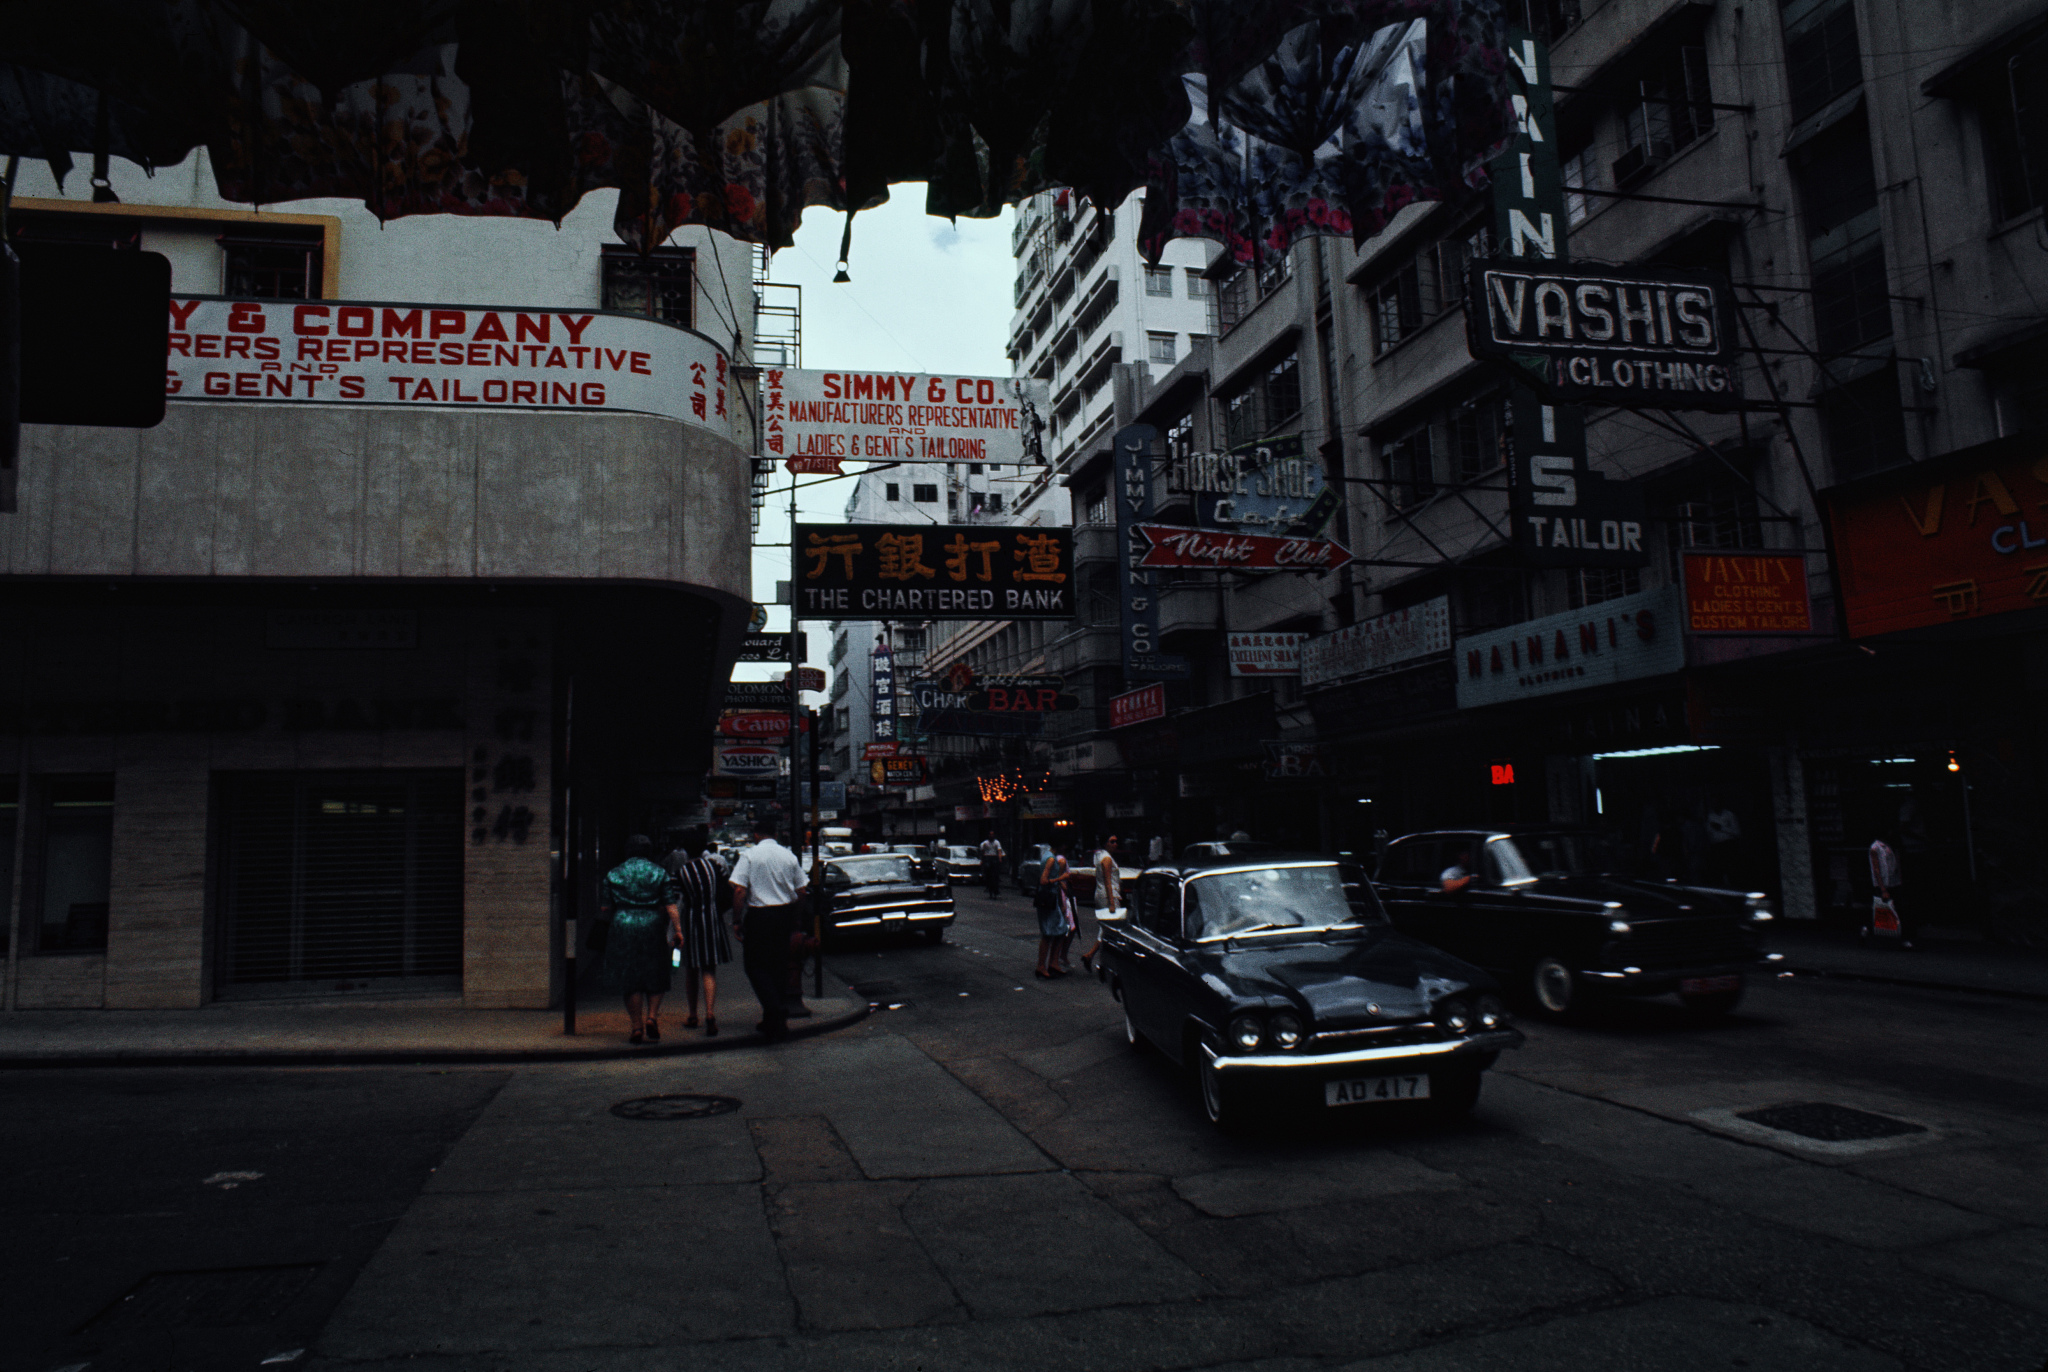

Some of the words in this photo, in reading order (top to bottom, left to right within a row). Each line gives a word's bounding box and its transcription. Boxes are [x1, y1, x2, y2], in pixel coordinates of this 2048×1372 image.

[228, 303, 265, 334] &
[293, 305, 594, 343] COMPANY
[1491, 277, 1715, 348] VASHIS
[261, 362, 339, 374] AND
[298, 338, 652, 375] REPRESENTATIVE
[204, 372, 365, 399] GENT'S
[388, 376, 606, 406] TAILORING
[824, 373, 916, 402] SIMMY
[927, 377, 946, 403] &
[956, 378, 1005, 405] CO.
[1569, 356, 1726, 392] CLOTHING
[789, 400, 903, 426] MANUFACTURERS
[908, 405, 1019, 430] REPRESENTATIVE
[797, 433, 845, 456] LADIES
[851, 435, 860, 456] &
[865, 435, 915, 458] GENT'S
[921, 436, 987, 460] TAILORING
[888, 427, 926, 435] AND
[1124, 438, 1145, 513] JIMMY
[1169, 441, 1248, 495] HORSE
[1255, 446, 1317, 499] SHOE
[1162, 533, 1255, 565] Night
[1273, 540, 1333, 565] Club
[1528, 516, 1643, 552] TAILOR
[805, 588, 849, 610] THE
[861, 588, 995, 610] CHARTERED
[1005, 588, 1065, 610] BANK
[742, 636, 784, 646] ouard
[1229, 649, 1272, 663] EXCELLENT
[987, 688, 1060, 712] BAR
[721, 754, 777, 767] YASHICA
[1375, 1076, 1419, 1099] 417
